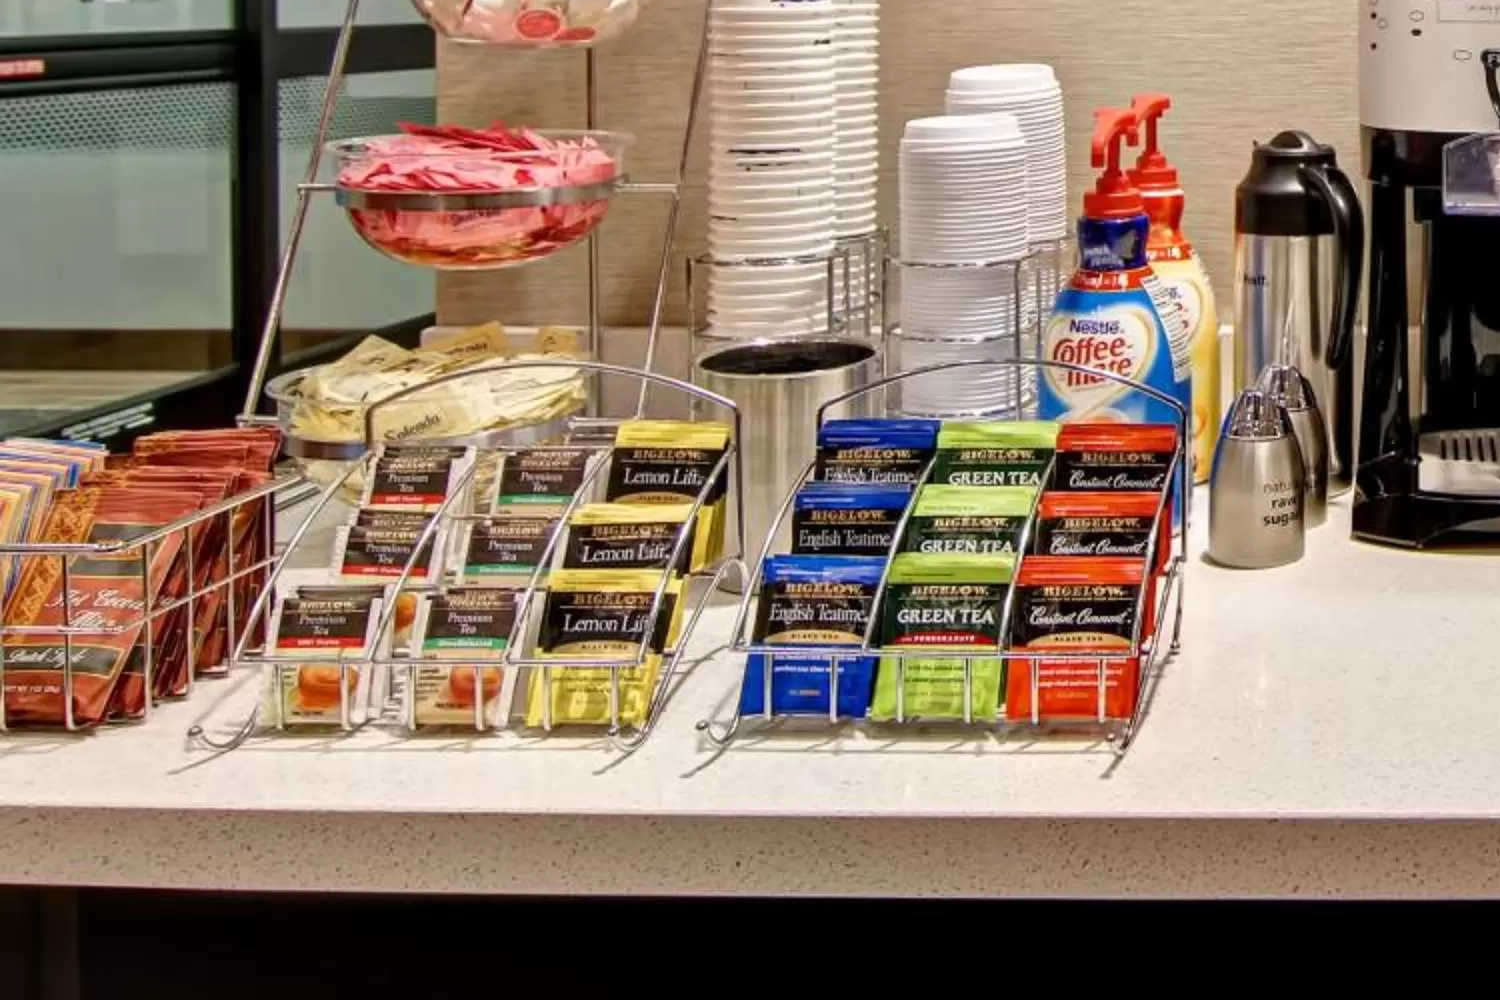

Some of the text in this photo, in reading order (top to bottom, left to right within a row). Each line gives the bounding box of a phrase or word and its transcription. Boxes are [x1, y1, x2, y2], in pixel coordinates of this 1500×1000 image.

[384, 414, 440, 440] Splenda
[837, 449, 911, 459] BIGELOW
[960, 449, 1034, 459] BIGELOW
[1081, 452, 1153, 463] BIGELOW
[623, 467, 700, 486] Lemon Lift
[824, 467, 867, 483] English
[949, 471, 1040, 485] GREEN TEA
[811, 511, 884, 521] BIGELOW
[1263, 512, 1302, 527] suga
[934, 518, 1007, 528] BIGELOW
[1062, 518, 1139, 528] BIGELOW
[592, 525, 667, 537] BIGELOW
[799, 529, 840, 549] English
[920, 540, 1014, 553] GREEN TEA
[582, 544, 635, 563] Lemon
[786, 582, 862, 594] BIGELOW
[912, 585, 987, 596] BIGELOW
[1043, 585, 1123, 597] BIGELOW
[573, 593, 651, 606] BIGELOW
[768, 603, 864, 624] English Teatime
[897, 608, 994, 625] GREEN TEA
[460, 623, 477, 635] Tea
[563, 613, 618, 633] Lemon
